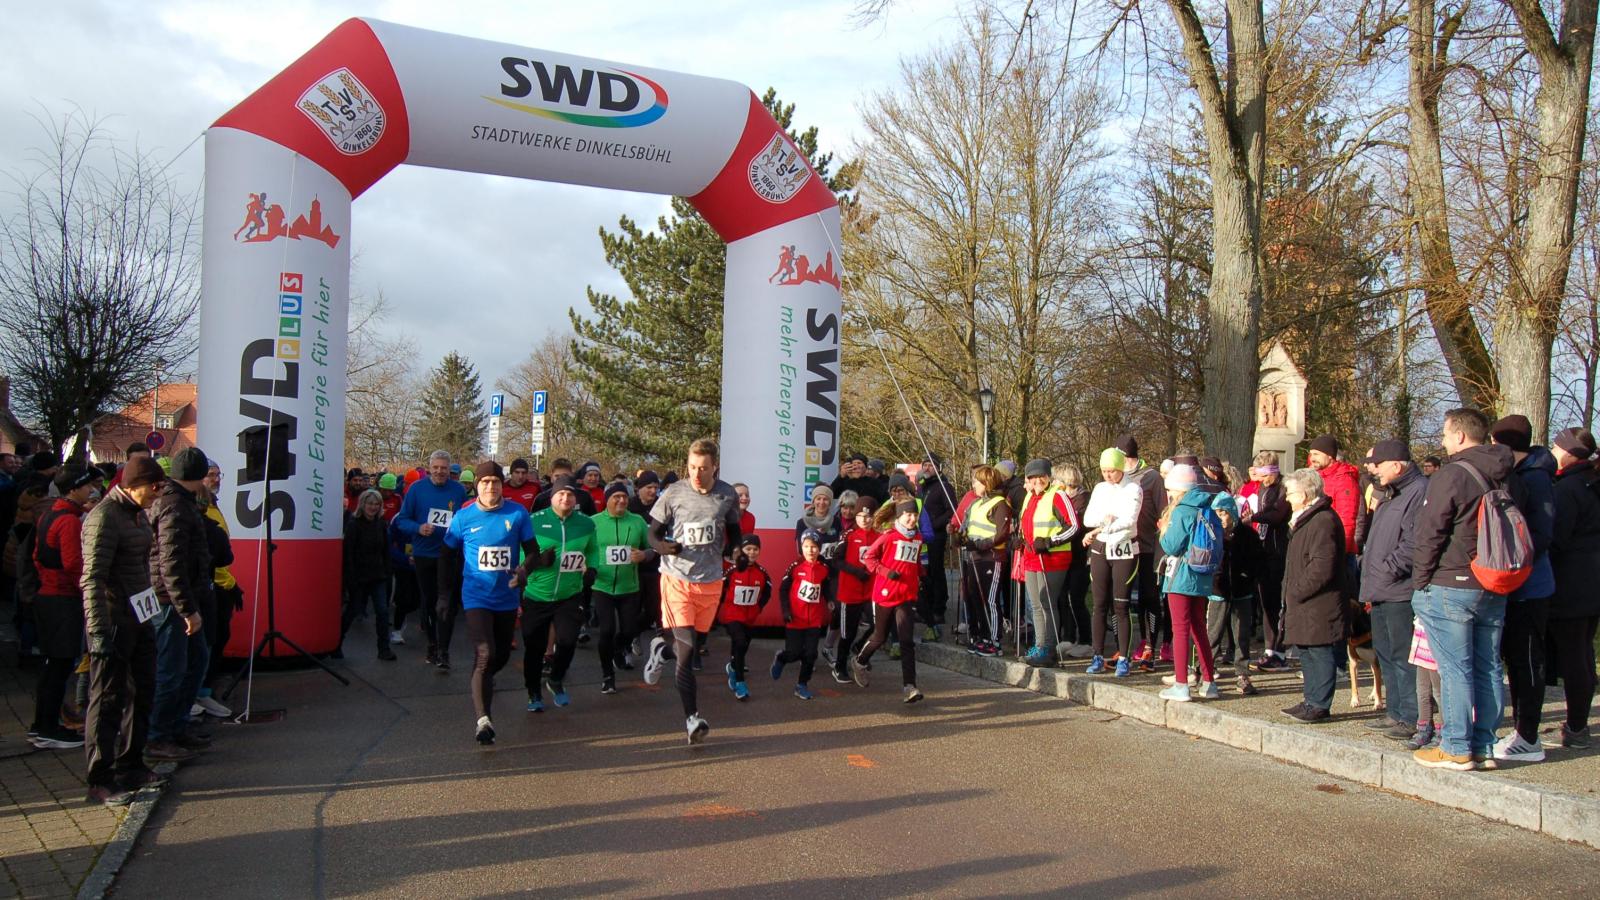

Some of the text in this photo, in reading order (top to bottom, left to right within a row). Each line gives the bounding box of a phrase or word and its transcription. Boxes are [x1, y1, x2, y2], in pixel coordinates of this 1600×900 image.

[500, 56, 640, 112] SWD
[354, 124, 373, 141] 1860
[471, 125, 672, 164] STADTWERKE DINKELSBÜHL
[761, 174, 776, 191] 1860
[279, 273, 302, 359] PLUS
[805, 308, 838, 466] SWD
[306, 277, 331, 531] mehr Energie für hier
[492, 396, 499, 413] P
[536, 394, 543, 412] P
[775, 306, 798, 519] mehr Energie für hier
[432, 511, 448, 526] 24
[689, 525, 714, 543] 373
[479, 550, 510, 569] 435
[610, 548, 628, 563] 50
[900, 542, 918, 560] 172
[560, 554, 584, 571] 472
[741, 589, 755, 603] 17
[136, 592, 160, 619] 141
